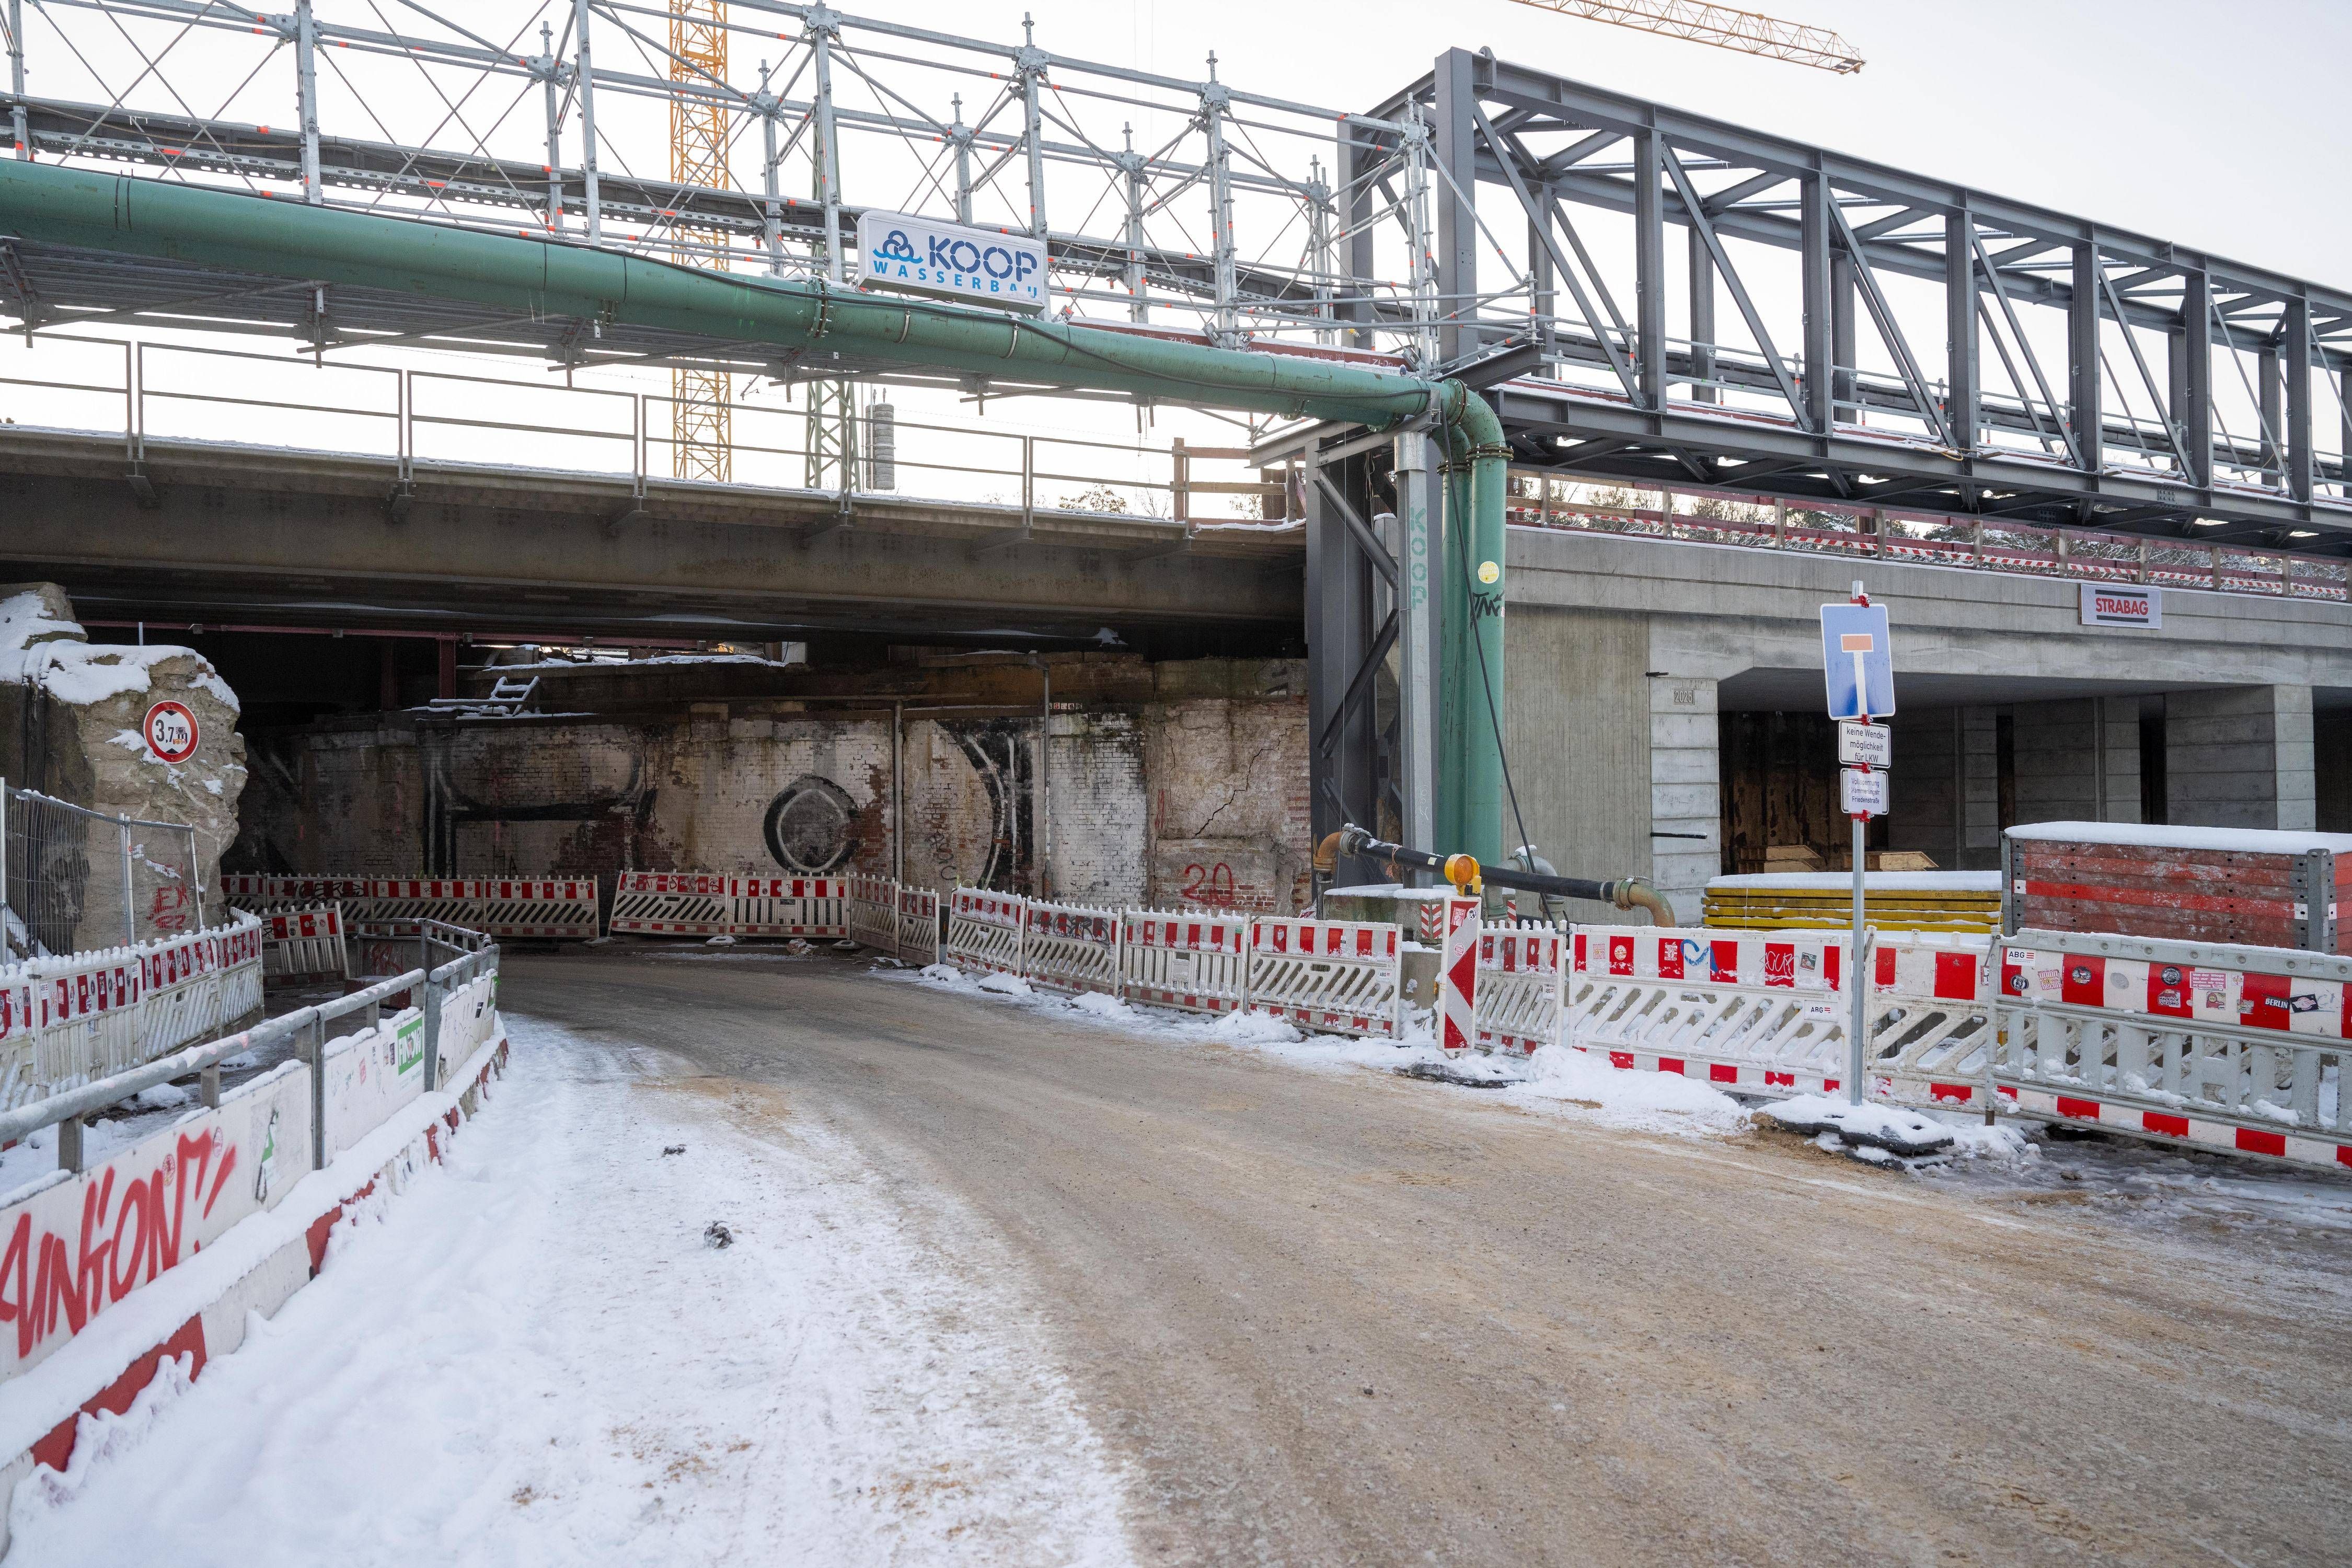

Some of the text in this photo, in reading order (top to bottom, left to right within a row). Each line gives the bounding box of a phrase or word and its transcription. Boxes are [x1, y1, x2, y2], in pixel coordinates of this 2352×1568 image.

[929, 235, 1037, 282] KOOP
[873, 260, 1037, 299] WASSERBAU
[1410, 507, 1427, 610] KOOP
[2095, 597, 2149, 615] STRABAG
[1674, 690, 1692, 702] 2025
[1847, 727, 1886, 740] keine Wende-
[1850, 740, 1883, 752] möglichkeit
[1855, 753, 1878, 763] für LKW
[1851, 778, 1880, 788] Vollsperrung
[1852, 795, 1880, 804] Friedenstraße
[2265, 997, 2289, 1009] BERLIN
